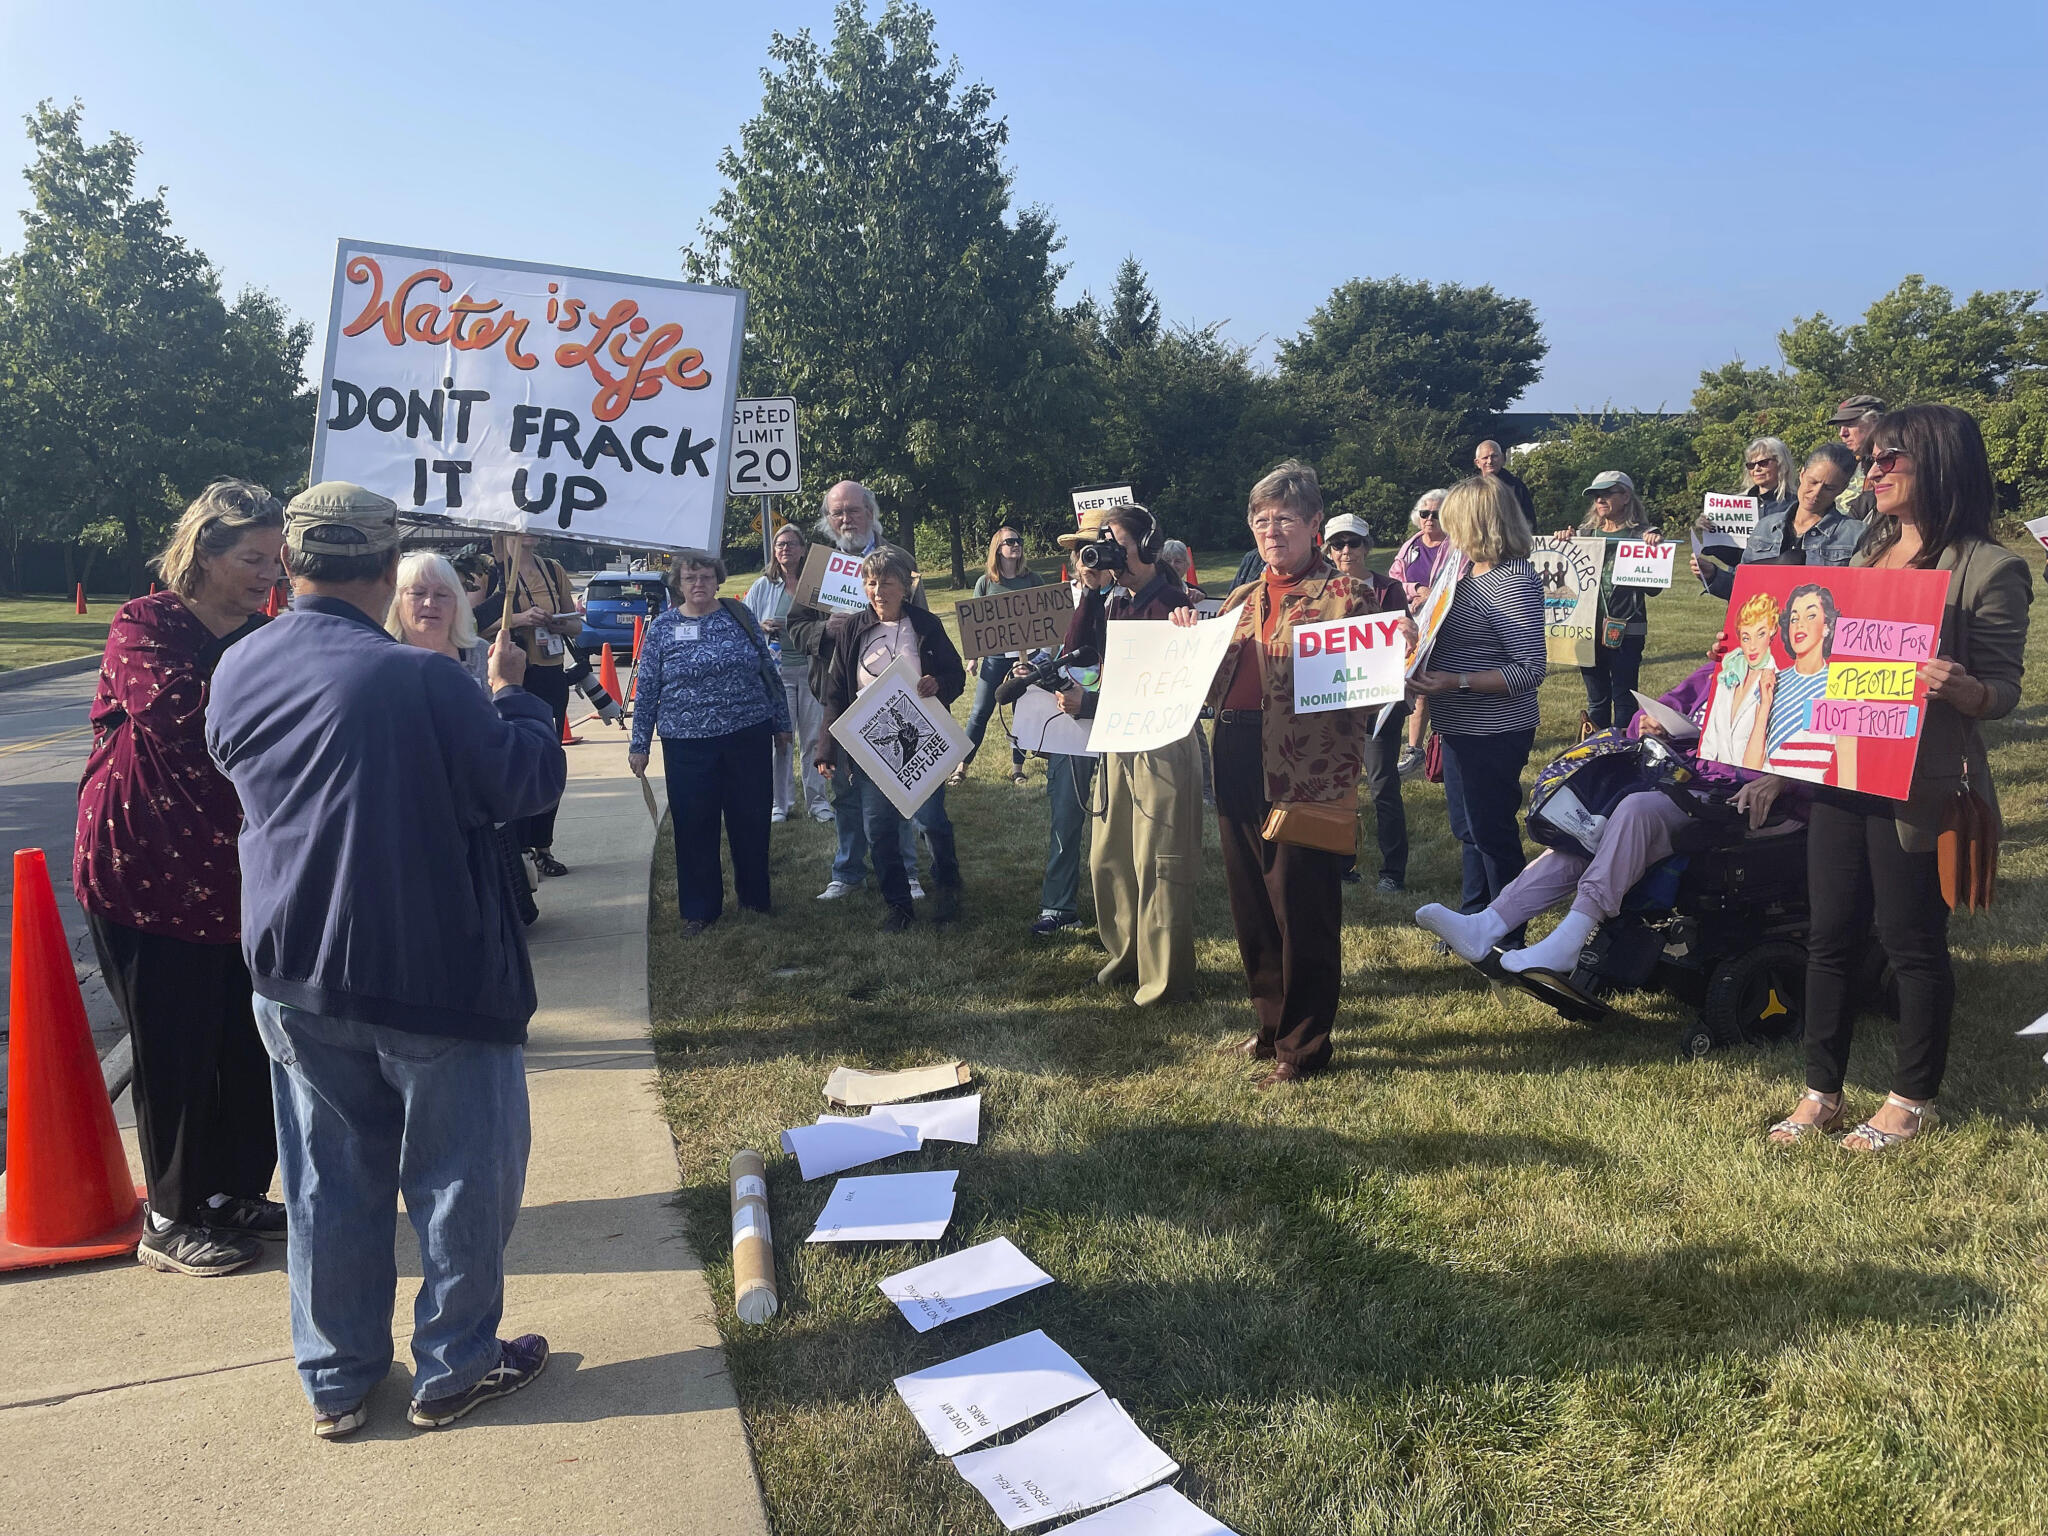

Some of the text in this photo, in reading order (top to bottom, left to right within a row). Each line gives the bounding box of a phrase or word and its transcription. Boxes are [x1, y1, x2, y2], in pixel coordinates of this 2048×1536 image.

[342, 256, 712, 422] Water is Life
[326, 376, 717, 477] DON'T FRACK
[733, 409, 790, 424] SPEED
[738, 429, 784, 444] LIMIT
[735, 448, 792, 483] 20
[413, 458, 607, 529] IT UP
[1078, 496, 1128, 510] KEEP THE
[1709, 498, 1752, 508] SHAME
[1708, 513, 1753, 521] SHAME
[1709, 525, 1753, 534] SHAME
[1619, 545, 1673, 559] DENY
[829, 557, 863, 578] DE
[1634, 566, 1653, 574] ALL
[840, 584, 858, 596] ALL
[1616, 576, 1669, 584] NOMINATIONS
[821, 593, 868, 610] NOMINATION
[975, 616, 1058, 651] FOREVER
[1300, 619, 1400, 658] DENY
[1842, 619, 1893, 654] PARKS
[1122, 638, 1136, 662] I
[1164, 638, 1201, 661] AM
[1332, 667, 1368, 683] ALL
[1837, 667, 1914, 697] PEOPLE
[1300, 685, 1400, 706] NOMINATIONS
[859, 707, 888, 735] TOGETHER
[886, 696, 899, 708] FOR
[1816, 703, 1908, 736] NOT PROFIT
[897, 733, 943, 784] FOSSIL FREE
[904, 741, 950, 791] FUTURE
[939, 1402, 956, 1416] MY
[967, 1404, 991, 1427] PARKS
[949, 1413, 971, 1434] LOVE
[992, 1474, 1013, 1490] REAL
[1013, 1495, 1030, 1509] AM
[1022, 1480, 1053, 1507] PERSON
